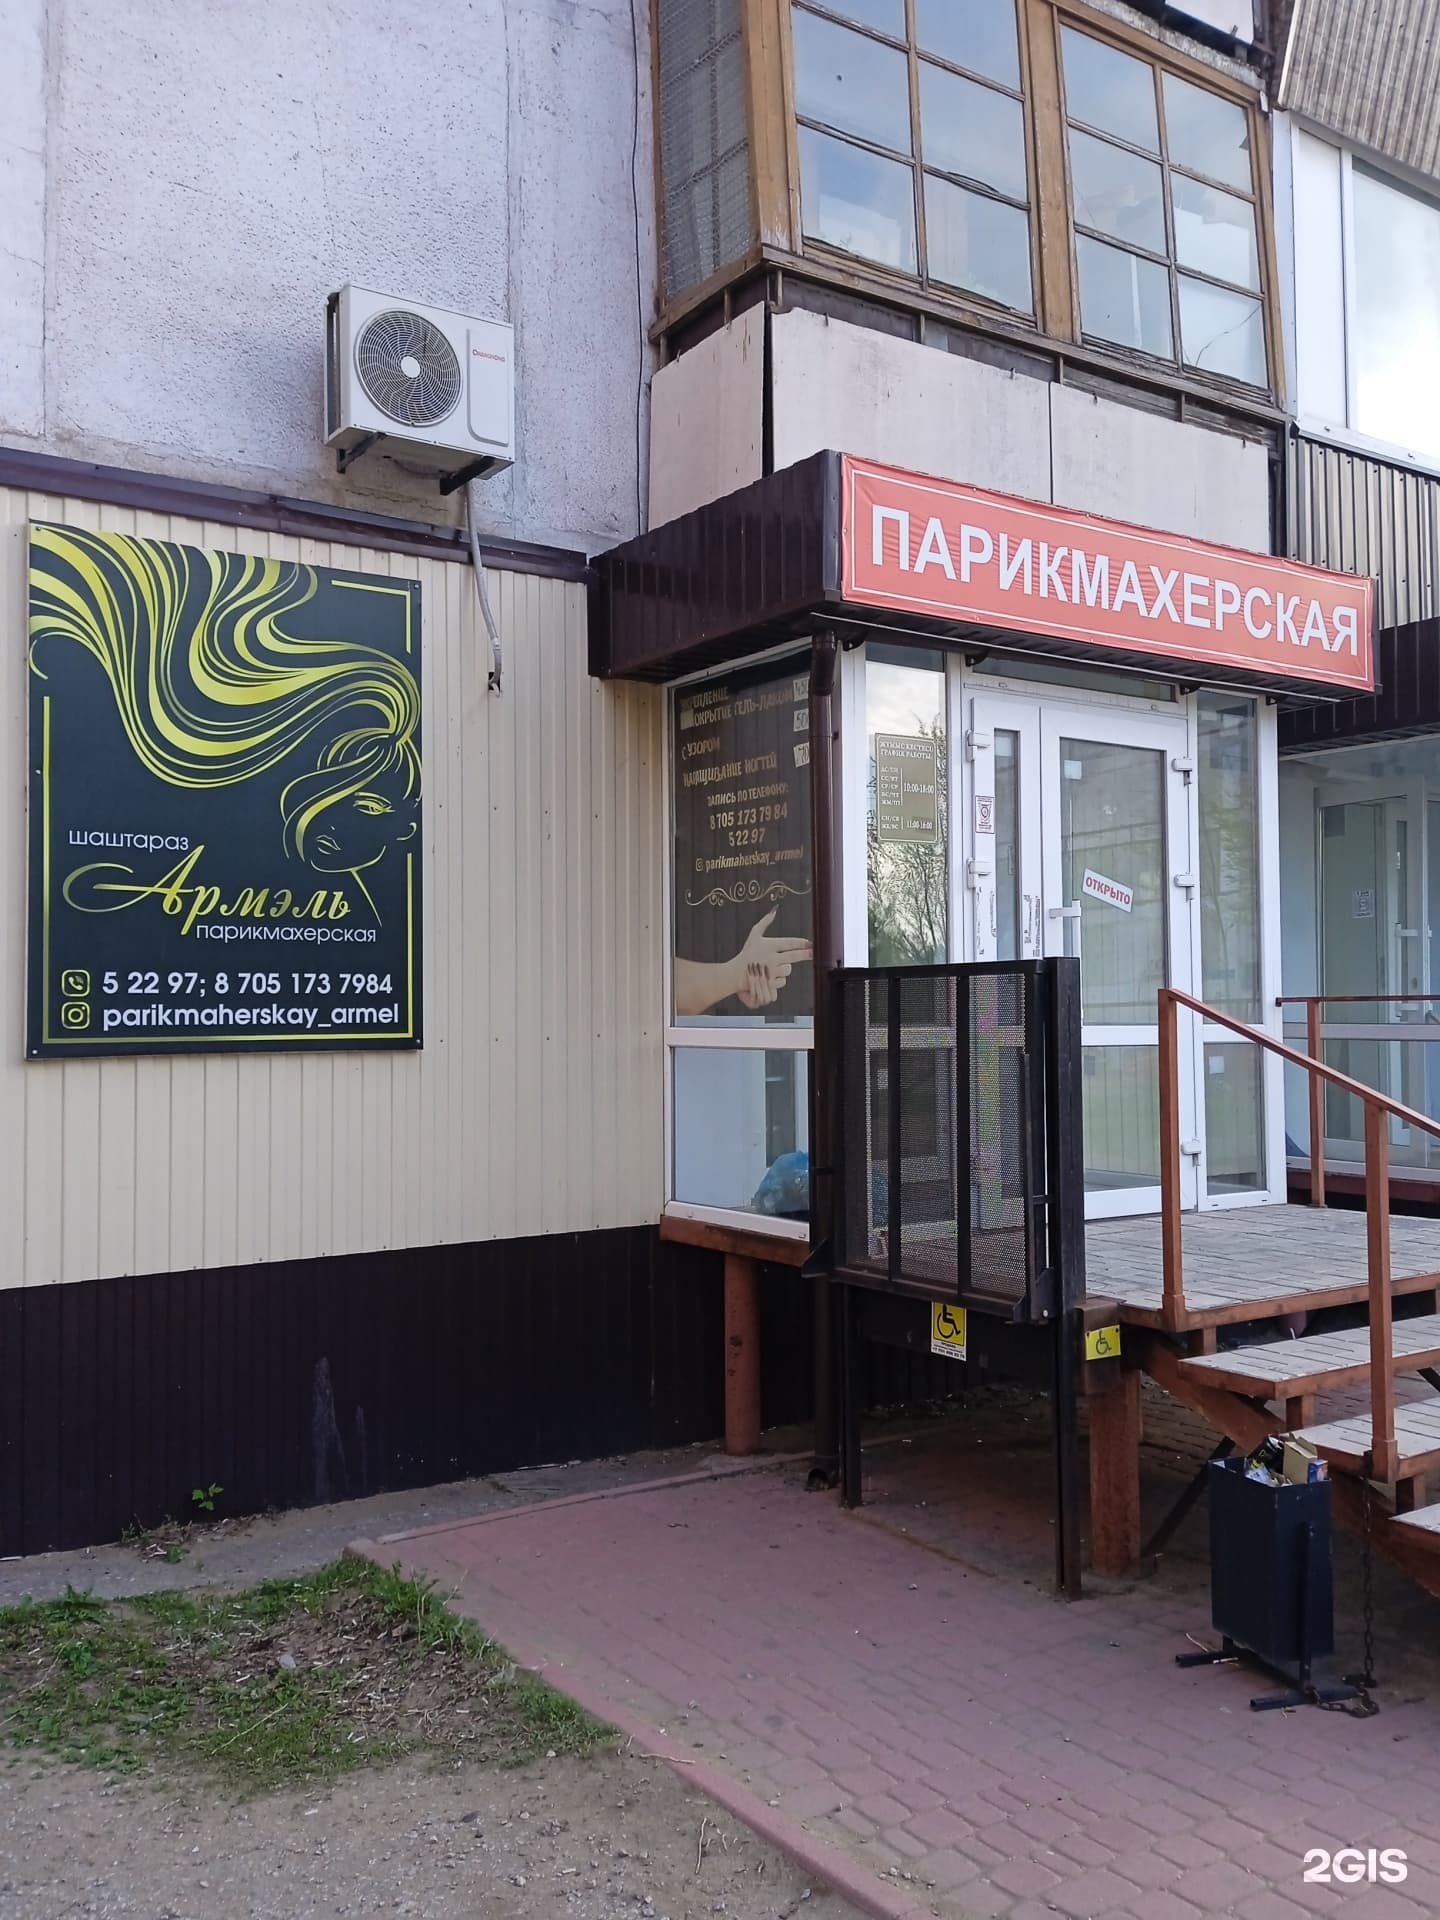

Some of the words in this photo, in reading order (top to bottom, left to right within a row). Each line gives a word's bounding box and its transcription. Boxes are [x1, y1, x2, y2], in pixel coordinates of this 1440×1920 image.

[871, 503, 1359, 657] ПАРИКМАХЕРСКАЯ
[690, 704, 732, 727] ОКРЫТИЕ
[710, 814, 716, 830] 8
[716, 811, 735, 828] 705
[737, 808, 757, 825] 173
[759, 805, 772, 822] 79
[774, 802, 788, 820] 84
[68, 829, 190, 853] шаштараз
[728, 831, 735, 847] 5
[735, 829, 749, 846] 22
[751, 827, 766, 843] 97
[62, 844, 351, 936] Армэль
[1085, 876, 1131, 905] ОТКРЫТО
[196, 924, 377, 945] парикмахерская
[102, 971, 119, 994] 5
[127, 971, 160, 994] 22
[167, 971, 206, 997] 97;
[214, 972, 230, 994] 8
[237, 972, 281, 994] 705
[291, 972, 331, 994] 173
[338, 973, 393, 994] 7984
[102, 1002, 400, 1032] parikmaherskay_armel
